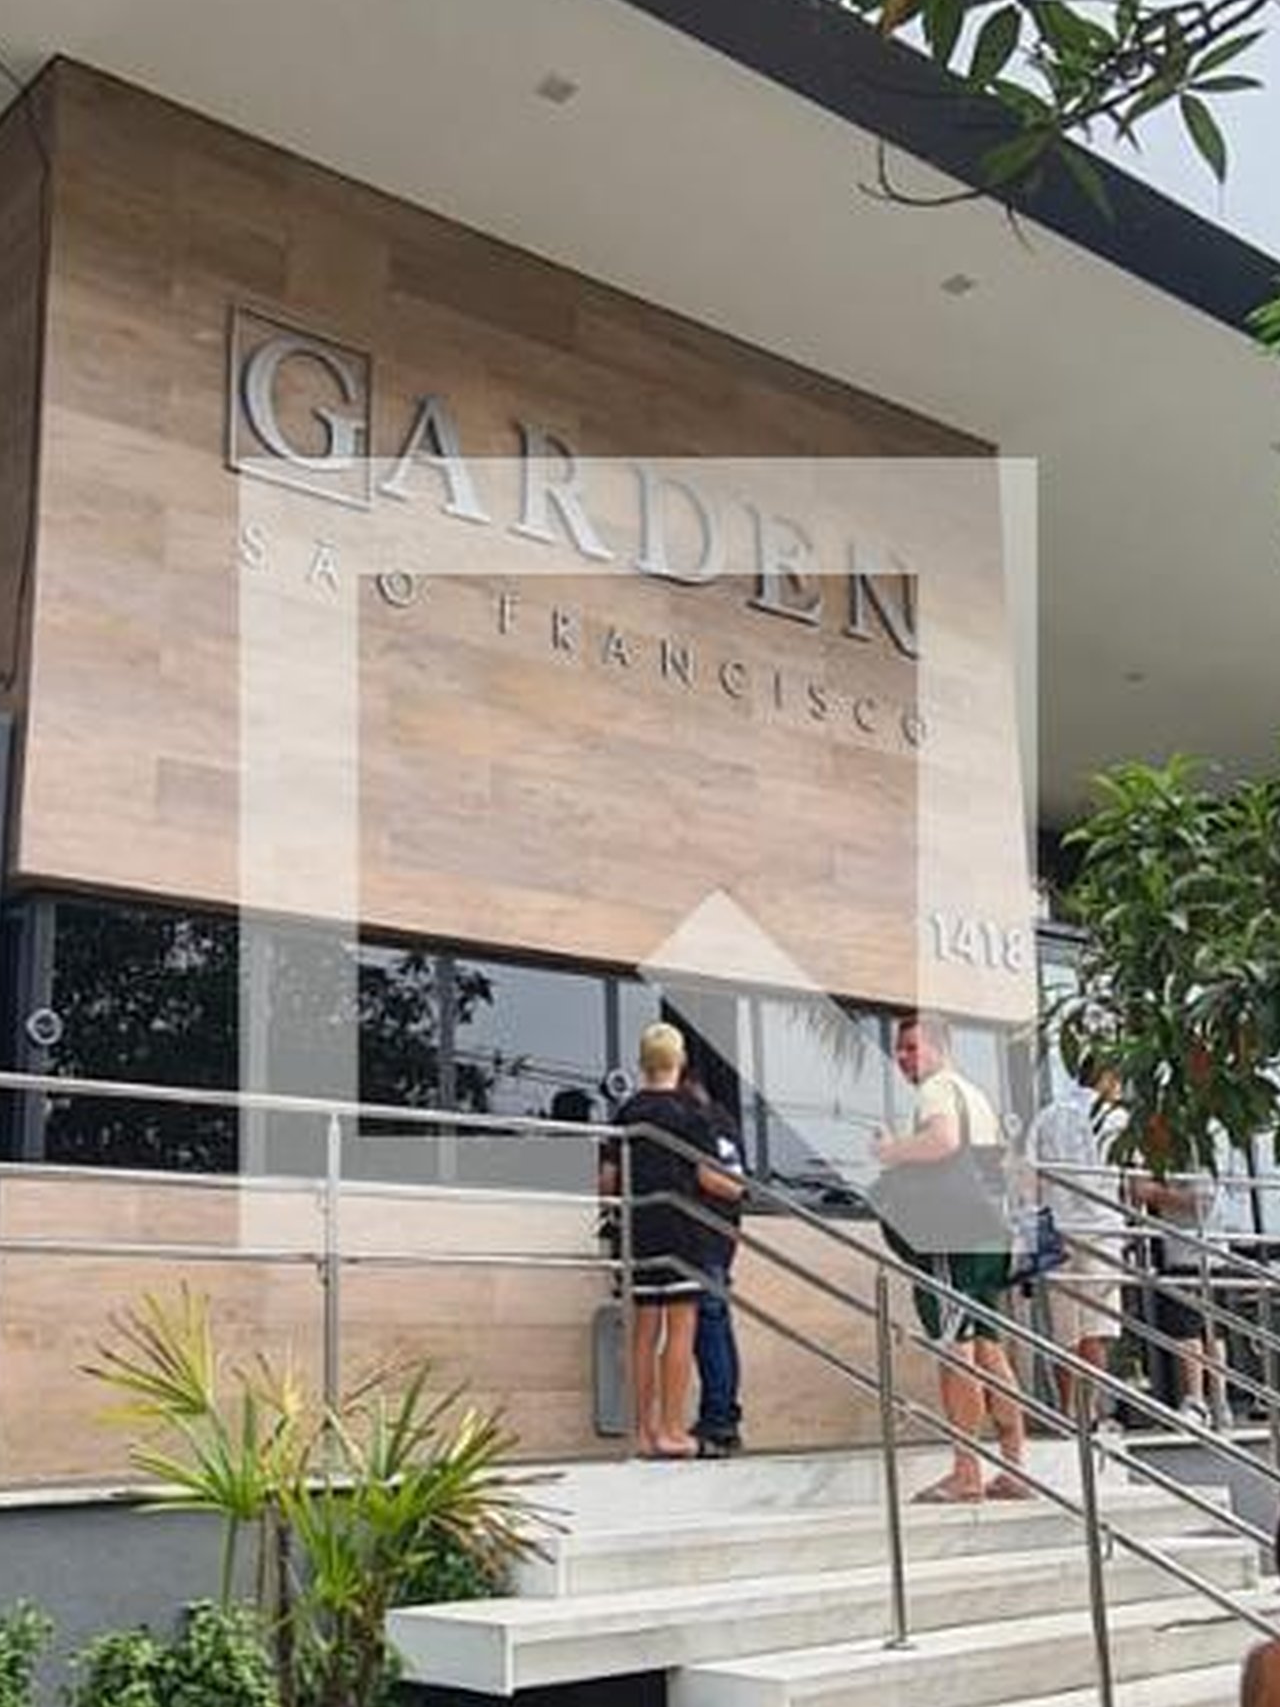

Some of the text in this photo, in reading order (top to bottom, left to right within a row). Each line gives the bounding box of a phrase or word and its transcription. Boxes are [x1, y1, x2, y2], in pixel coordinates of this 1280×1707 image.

[242, 334, 924, 658] GARDEN
[497, 593, 932, 747] FRANCISCO
[930, 910, 1027, 974] 1418
